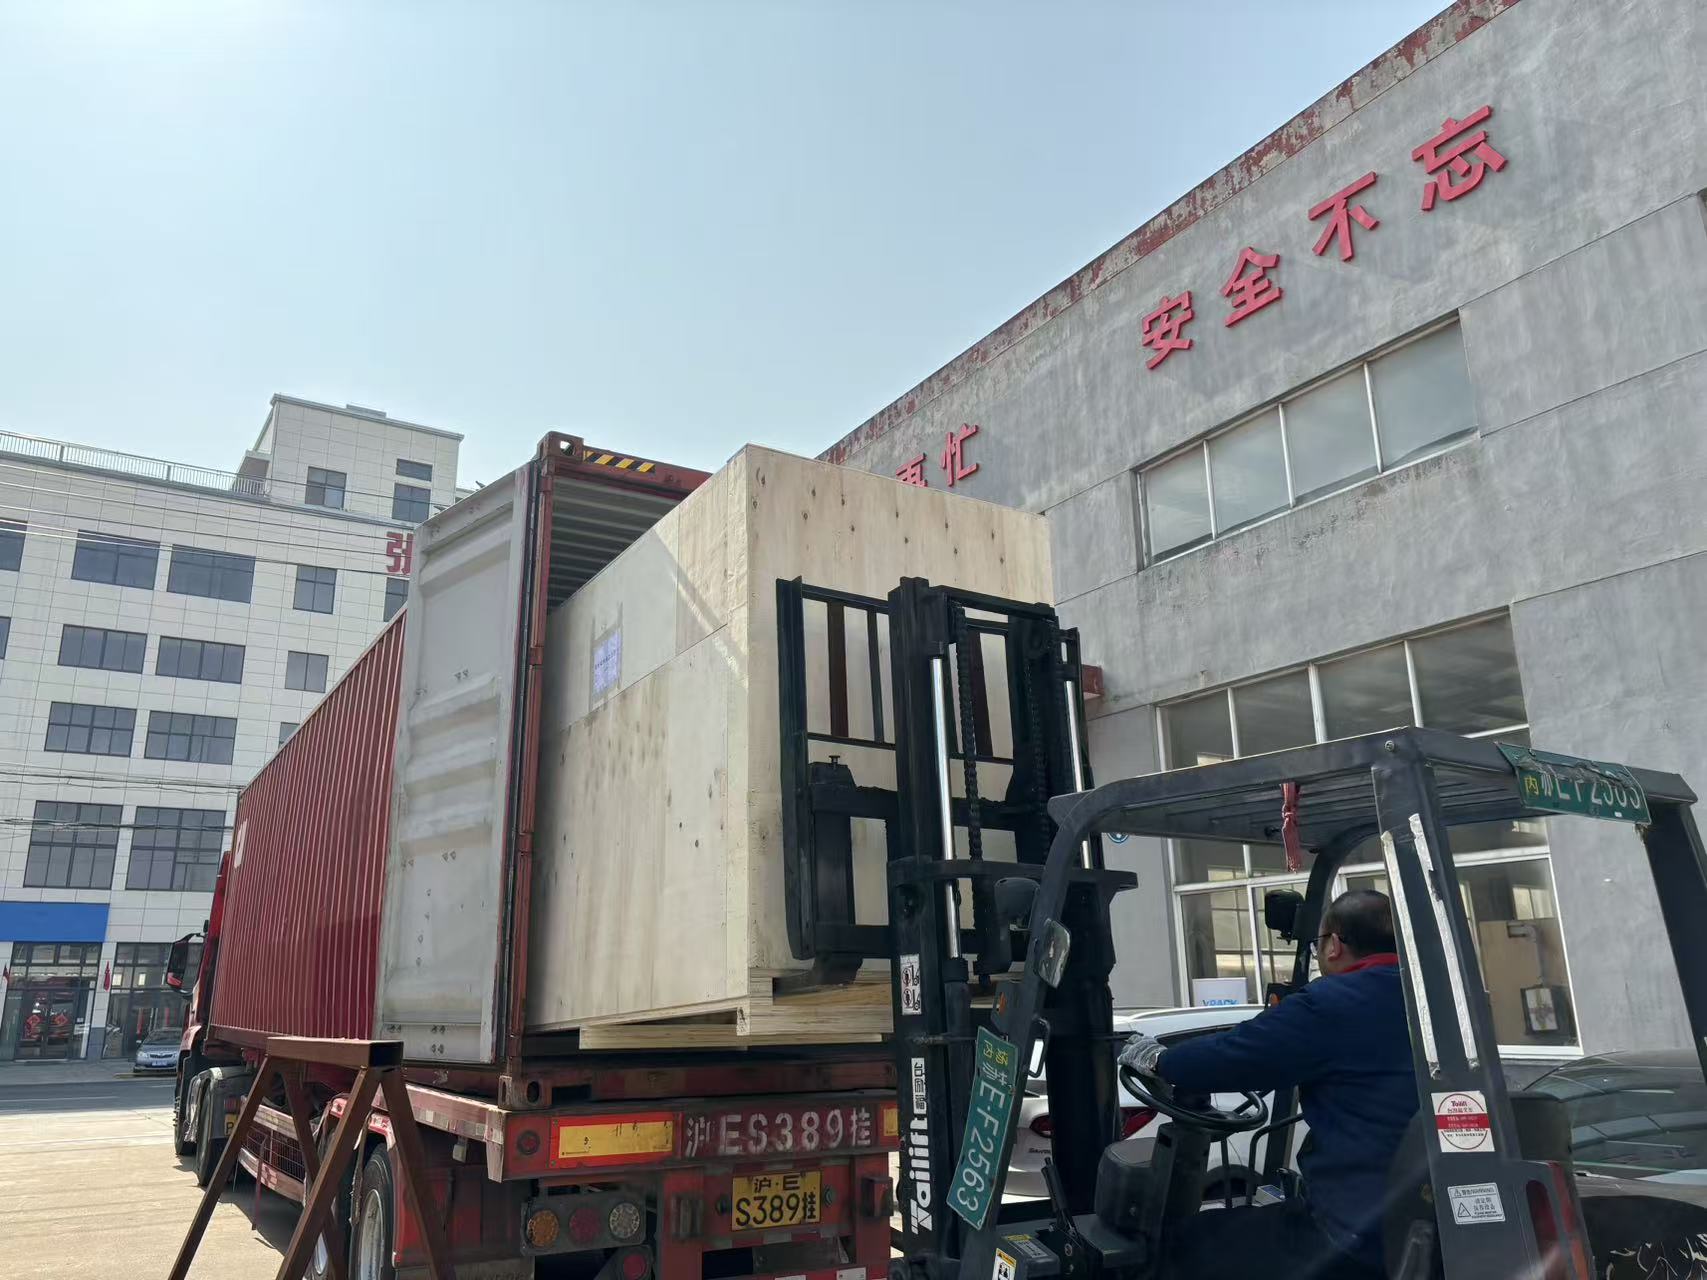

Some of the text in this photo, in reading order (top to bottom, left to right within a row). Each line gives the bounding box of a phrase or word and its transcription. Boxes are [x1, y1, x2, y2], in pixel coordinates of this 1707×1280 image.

[1141, 105, 1508, 370] 安全不忘
[735, 1191, 816, 1227] S389挂
